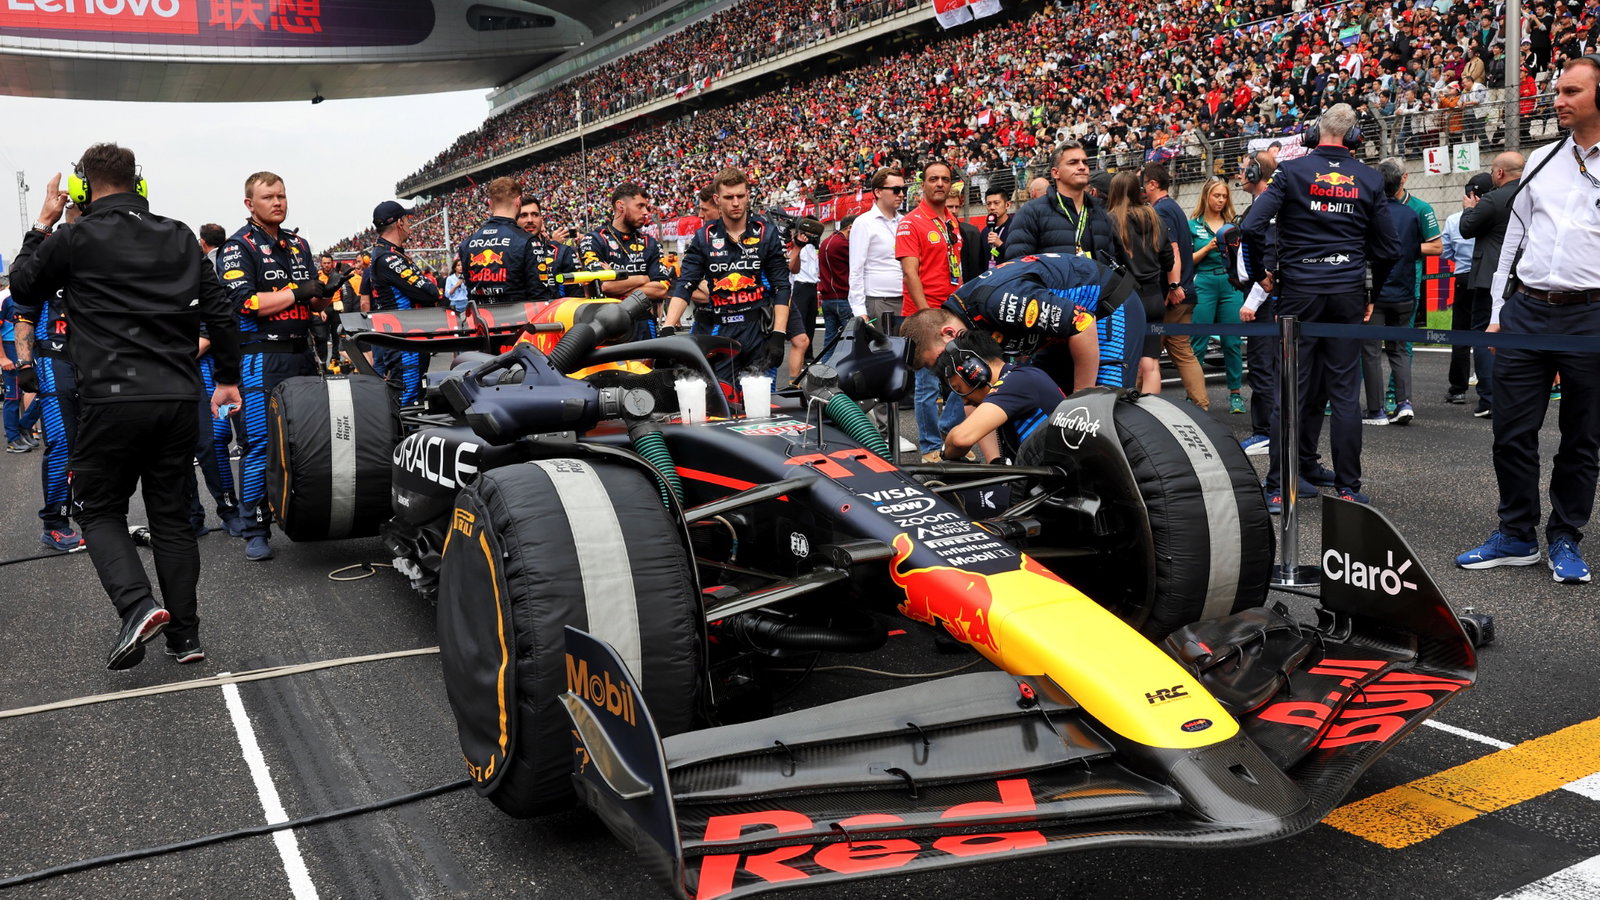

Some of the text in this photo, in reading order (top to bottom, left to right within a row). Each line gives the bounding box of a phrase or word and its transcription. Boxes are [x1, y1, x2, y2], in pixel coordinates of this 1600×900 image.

[8, 0, 179, 18] ovo
[1309, 184, 1359, 199] Red Bull
[1310, 201, 1342, 213] Mobil
[468, 238, 512, 248] ORACLE
[264, 270, 310, 280] ORCLE
[483, 267, 507, 282] Bull
[709, 260, 761, 273] ORACLE
[711, 286, 765, 307] Red Bull
[1005, 293, 1019, 323] ROKT
[343, 415, 352, 441] Right
[1172, 423, 1197, 450] Left
[1184, 424, 1213, 460] Front
[393, 433, 479, 489] ORACLE
[783, 448, 898, 479] 11
[857, 486, 925, 502] VISA
[876, 500, 924, 515] CDW
[894, 511, 961, 528] zoom
[930, 520, 971, 532] ARCTIC
[939, 525, 972, 535] WOLF
[923, 532, 990, 549] PIRELLI
[935, 541, 1002, 558] Infinitum
[946, 551, 999, 567] Mobil
[565, 653, 636, 728] Mobil
[1144, 684, 1189, 705] HRC
[695, 778, 1048, 900] Red
